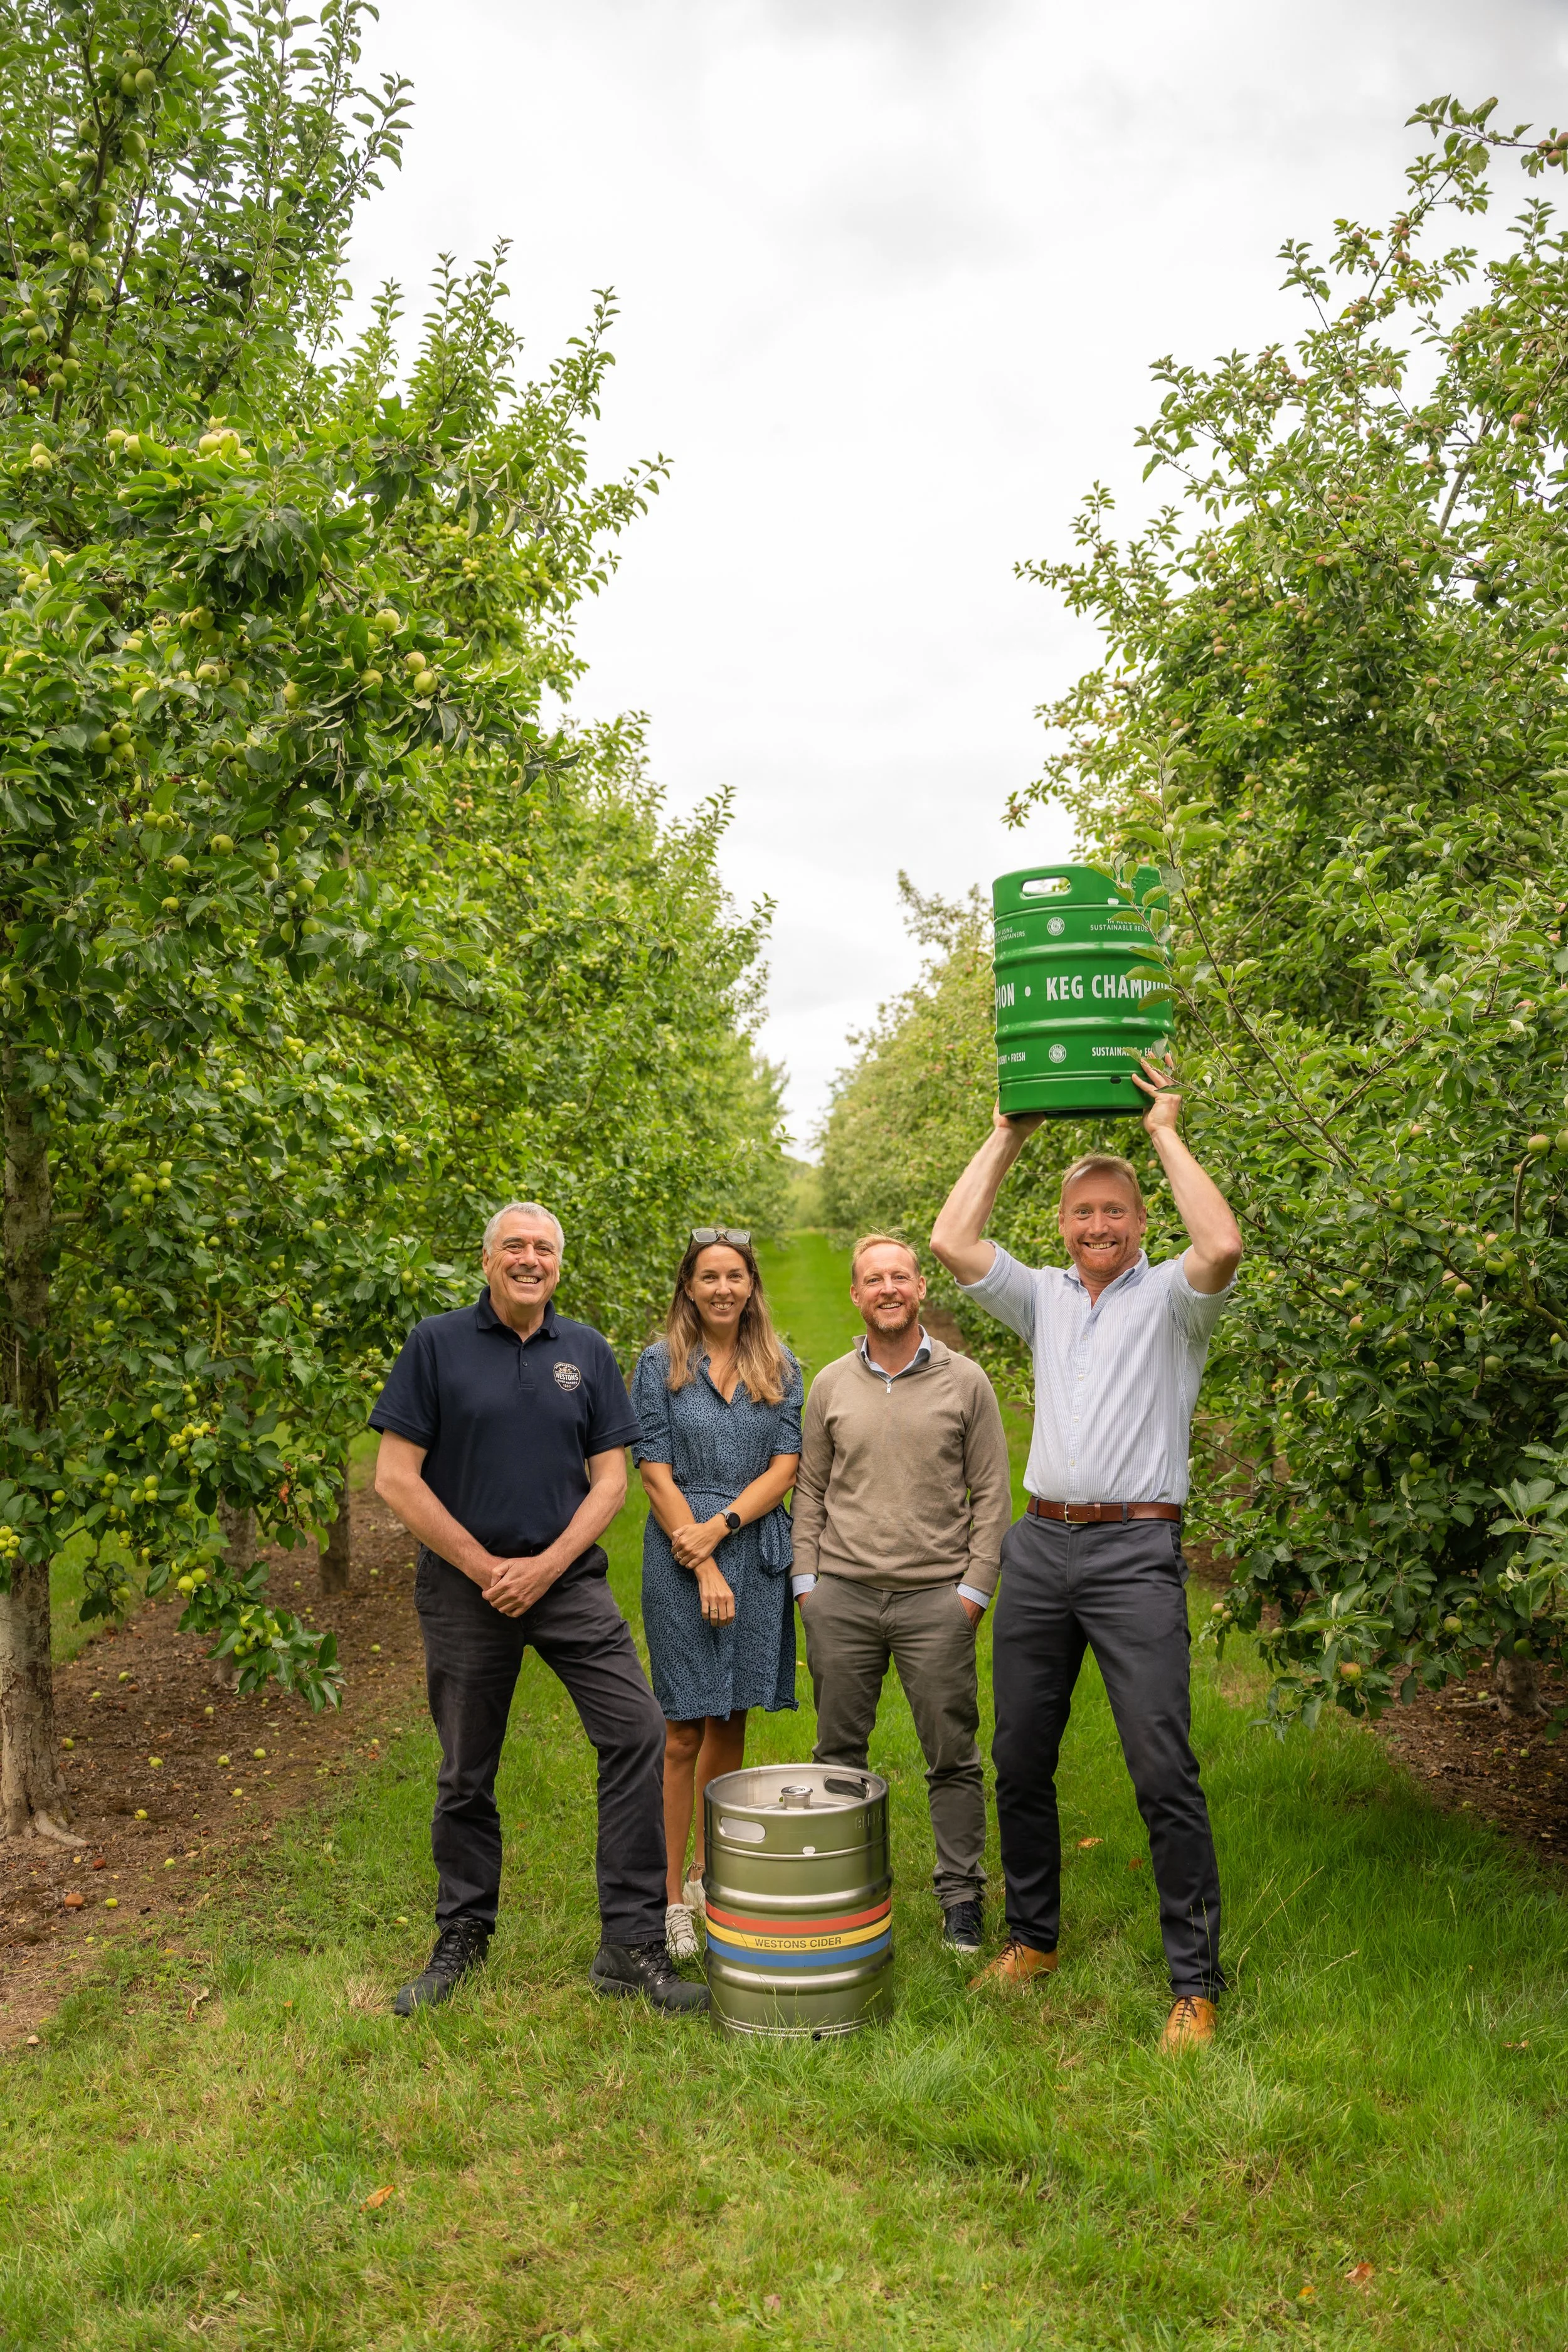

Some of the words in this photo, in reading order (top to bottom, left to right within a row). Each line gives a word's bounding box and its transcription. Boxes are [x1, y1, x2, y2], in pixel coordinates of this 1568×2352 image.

[1000, 930, 1025, 942] CONTAINERS
[1002, 926, 1013, 935] USING
[1046, 975, 1084, 1001] KEG
[1011, 1051, 1025, 1063] FRESH
[555, 1372, 579, 1380] WESTONS
[755, 1938, 807, 1949] WESTONS
[810, 1937, 841, 1947] CIDER
